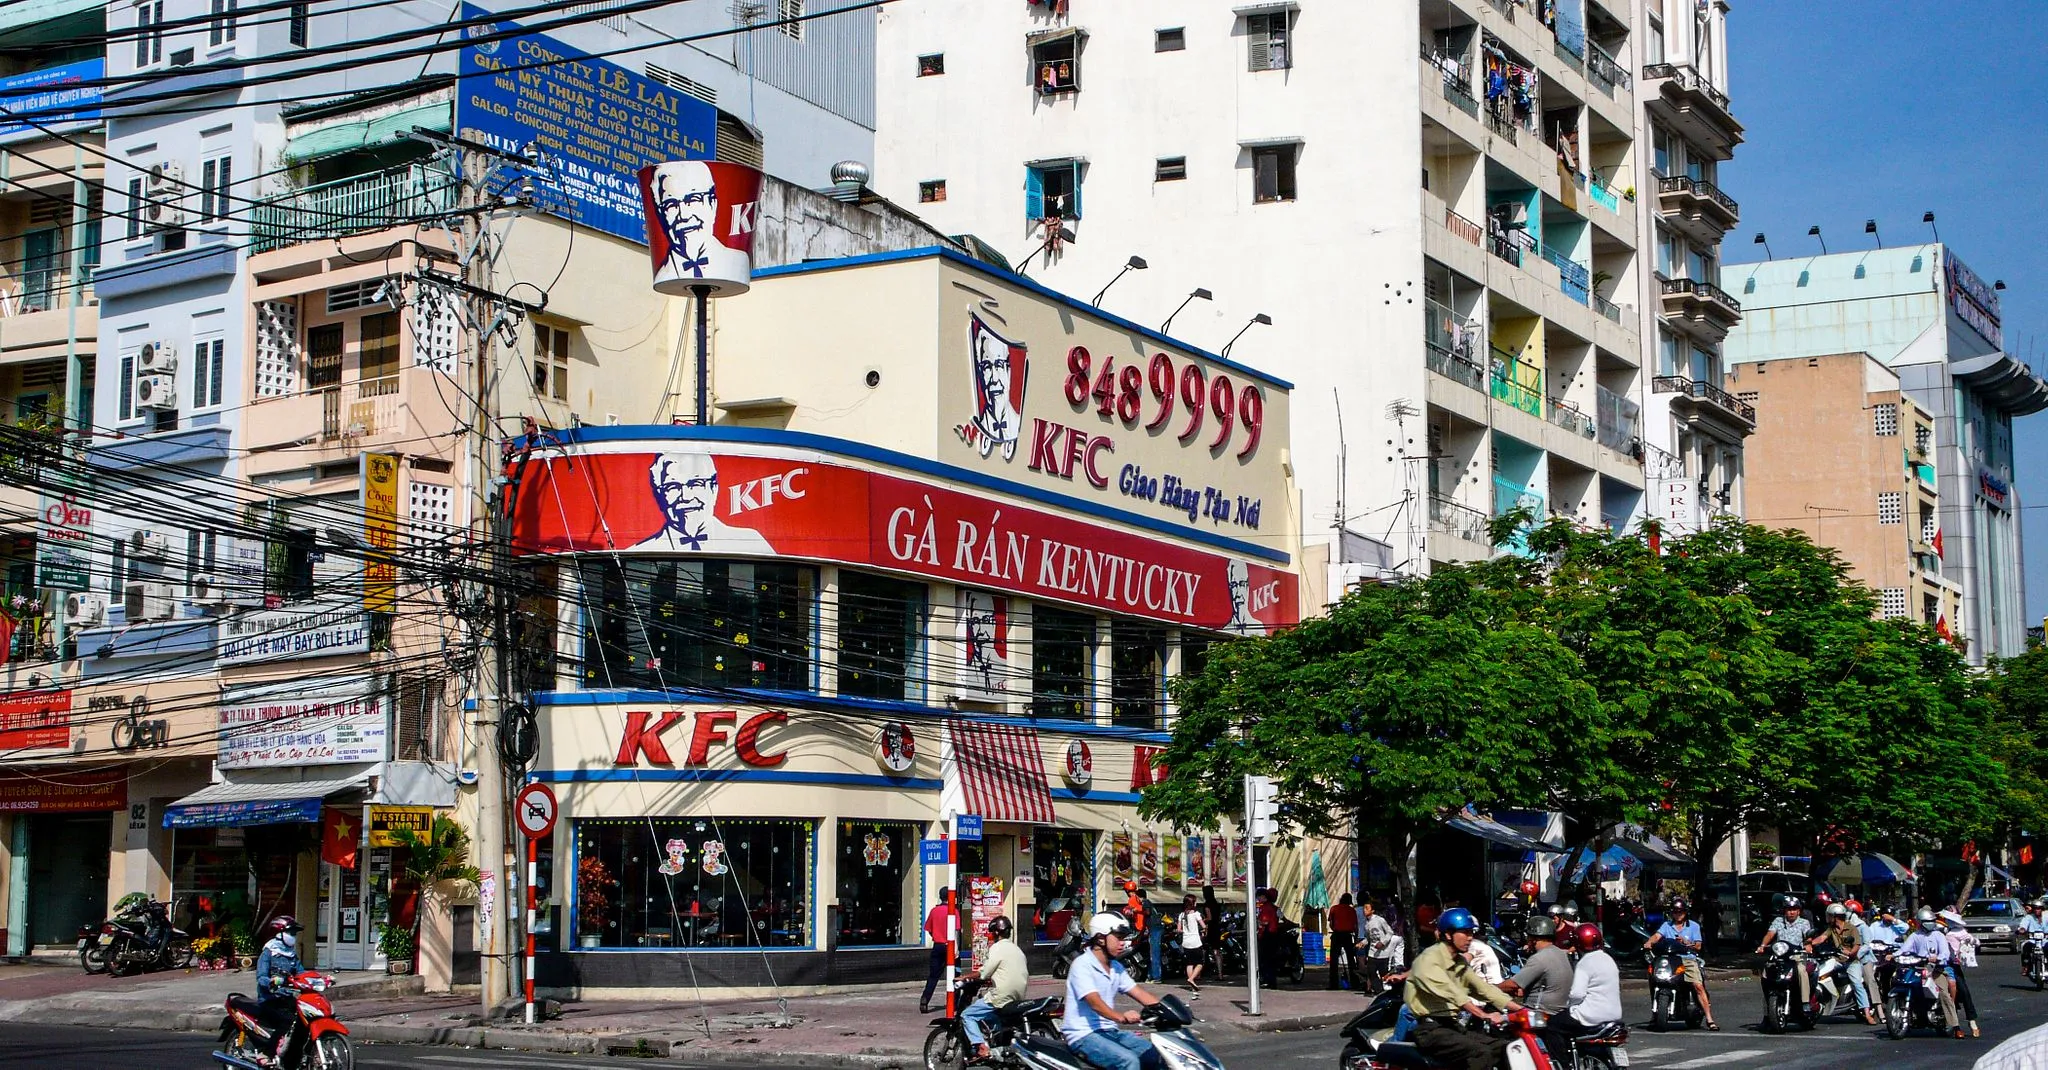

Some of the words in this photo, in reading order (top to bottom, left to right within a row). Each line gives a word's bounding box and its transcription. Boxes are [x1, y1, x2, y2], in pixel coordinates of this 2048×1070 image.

[517, 39, 566, 70] CÔNG
[570, 61, 593, 80] TY
[598, 66, 630, 94] LÊ
[636, 82, 678, 115] LAI
[494, 77, 515, 93] NHÀ
[519, 85, 545, 104] PHÂN
[549, 96, 570, 113] PHỐI
[645, 135, 664, 149] VIỆT
[667, 144, 687, 158] NAM
[516, 98, 563, 123] EXCLUSIVE
[565, 117, 620, 144] DISTRIBUTOR
[620, 138, 630, 148] IN
[518, 70, 542, 89] MỸ
[547, 81, 594, 109] THUẬT
[599, 102, 628, 121] CAO
[631, 116, 659, 133] CẤP
[663, 128, 679, 143] LÊ
[683, 135, 705, 153] LAI
[536, 134, 562, 150] HIGH
[565, 144, 609, 168] QUALITY
[612, 161, 629, 175] ISO
[577, 134, 611, 155] BRIGHT
[613, 147, 639, 166] LINEN
[568, 162, 591, 179] BAY
[592, 172, 623, 191] QUỐC
[1028, 417, 1114, 488] KFC
[1118, 463, 1158, 499] Giao
[1160, 474, 1200, 522] Hàng
[1203, 486, 1230, 525] Tận
[1236, 495, 1261, 529] Nơi
[46, 493, 92, 527] Sen
[728, 467, 807, 517] KFC
[369, 523, 390, 548] LÊ
[886, 494, 941, 566] GÀ
[951, 509, 1031, 587] RÁN
[1036, 538, 1203, 617] KENTUCKY
[1252, 579, 1281, 612] KFC
[294, 634, 313, 651] BAY
[315, 631, 327, 648] 80
[331, 627, 342, 647] LÊ
[346, 629, 362, 646] LAI
[112, 695, 169, 752] Sen
[303, 704, 309, 718] &
[349, 699, 360, 715] LÊ
[364, 700, 380, 715] LAI
[614, 711, 789, 767] KFC
[131, 804, 146, 819] 82
[373, 813, 420, 822] WESTERN
[387, 821, 420, 830] UNION
